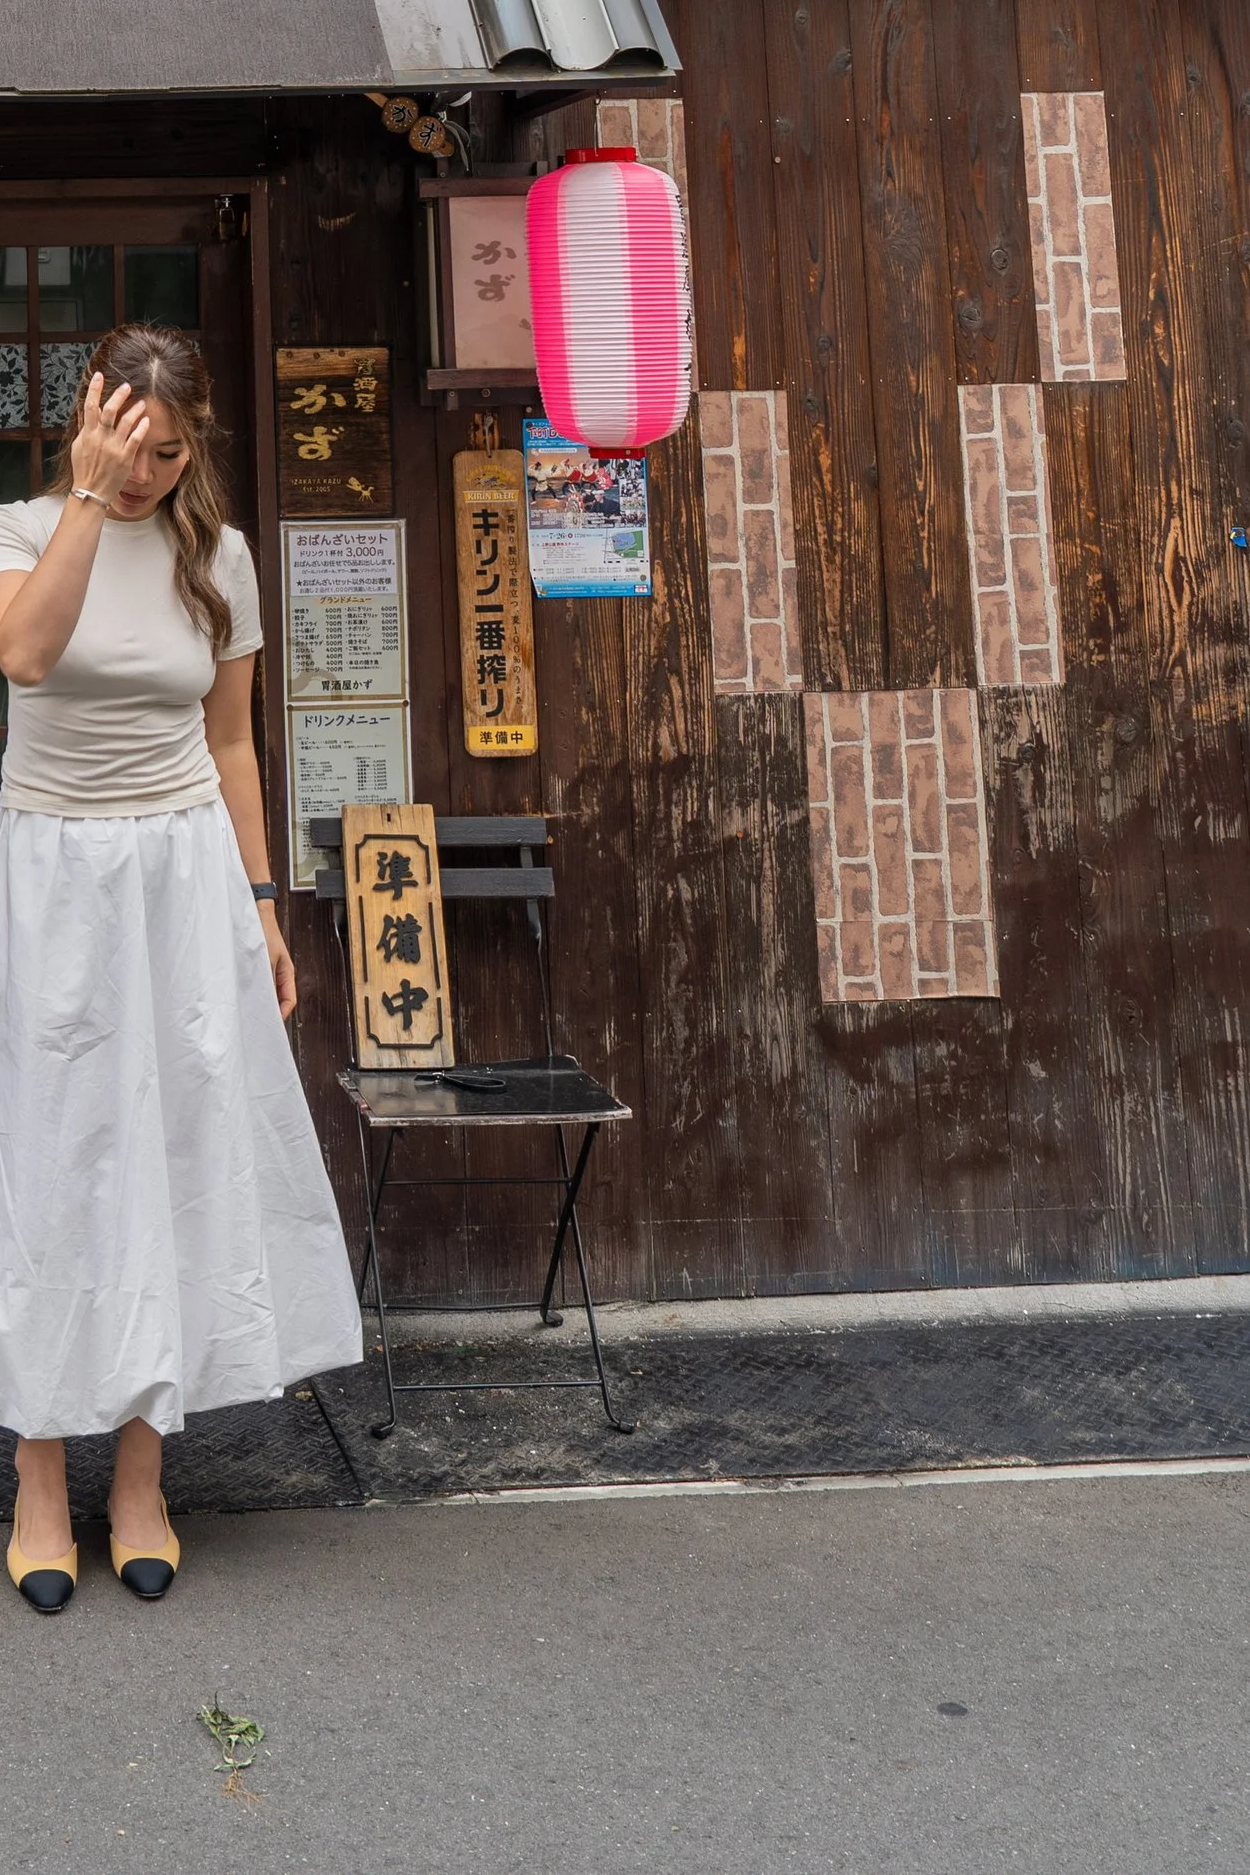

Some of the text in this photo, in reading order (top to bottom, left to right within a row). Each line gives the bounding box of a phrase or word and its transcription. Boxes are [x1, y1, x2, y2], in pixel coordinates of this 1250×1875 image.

[290, 384, 347, 461] かず
[493, 492, 515, 500] BEER
[296, 533, 388, 546] おばんざいセット
[346, 547, 384, 558] 3,000円
[320, 596, 372, 604] グランドメニュー
[472, 509, 507, 718] キリン一番搾り
[305, 714, 390, 728] ドリンクメニュー
[480, 731, 523, 745] 準備中
[373, 850, 429, 1031] 準備中
